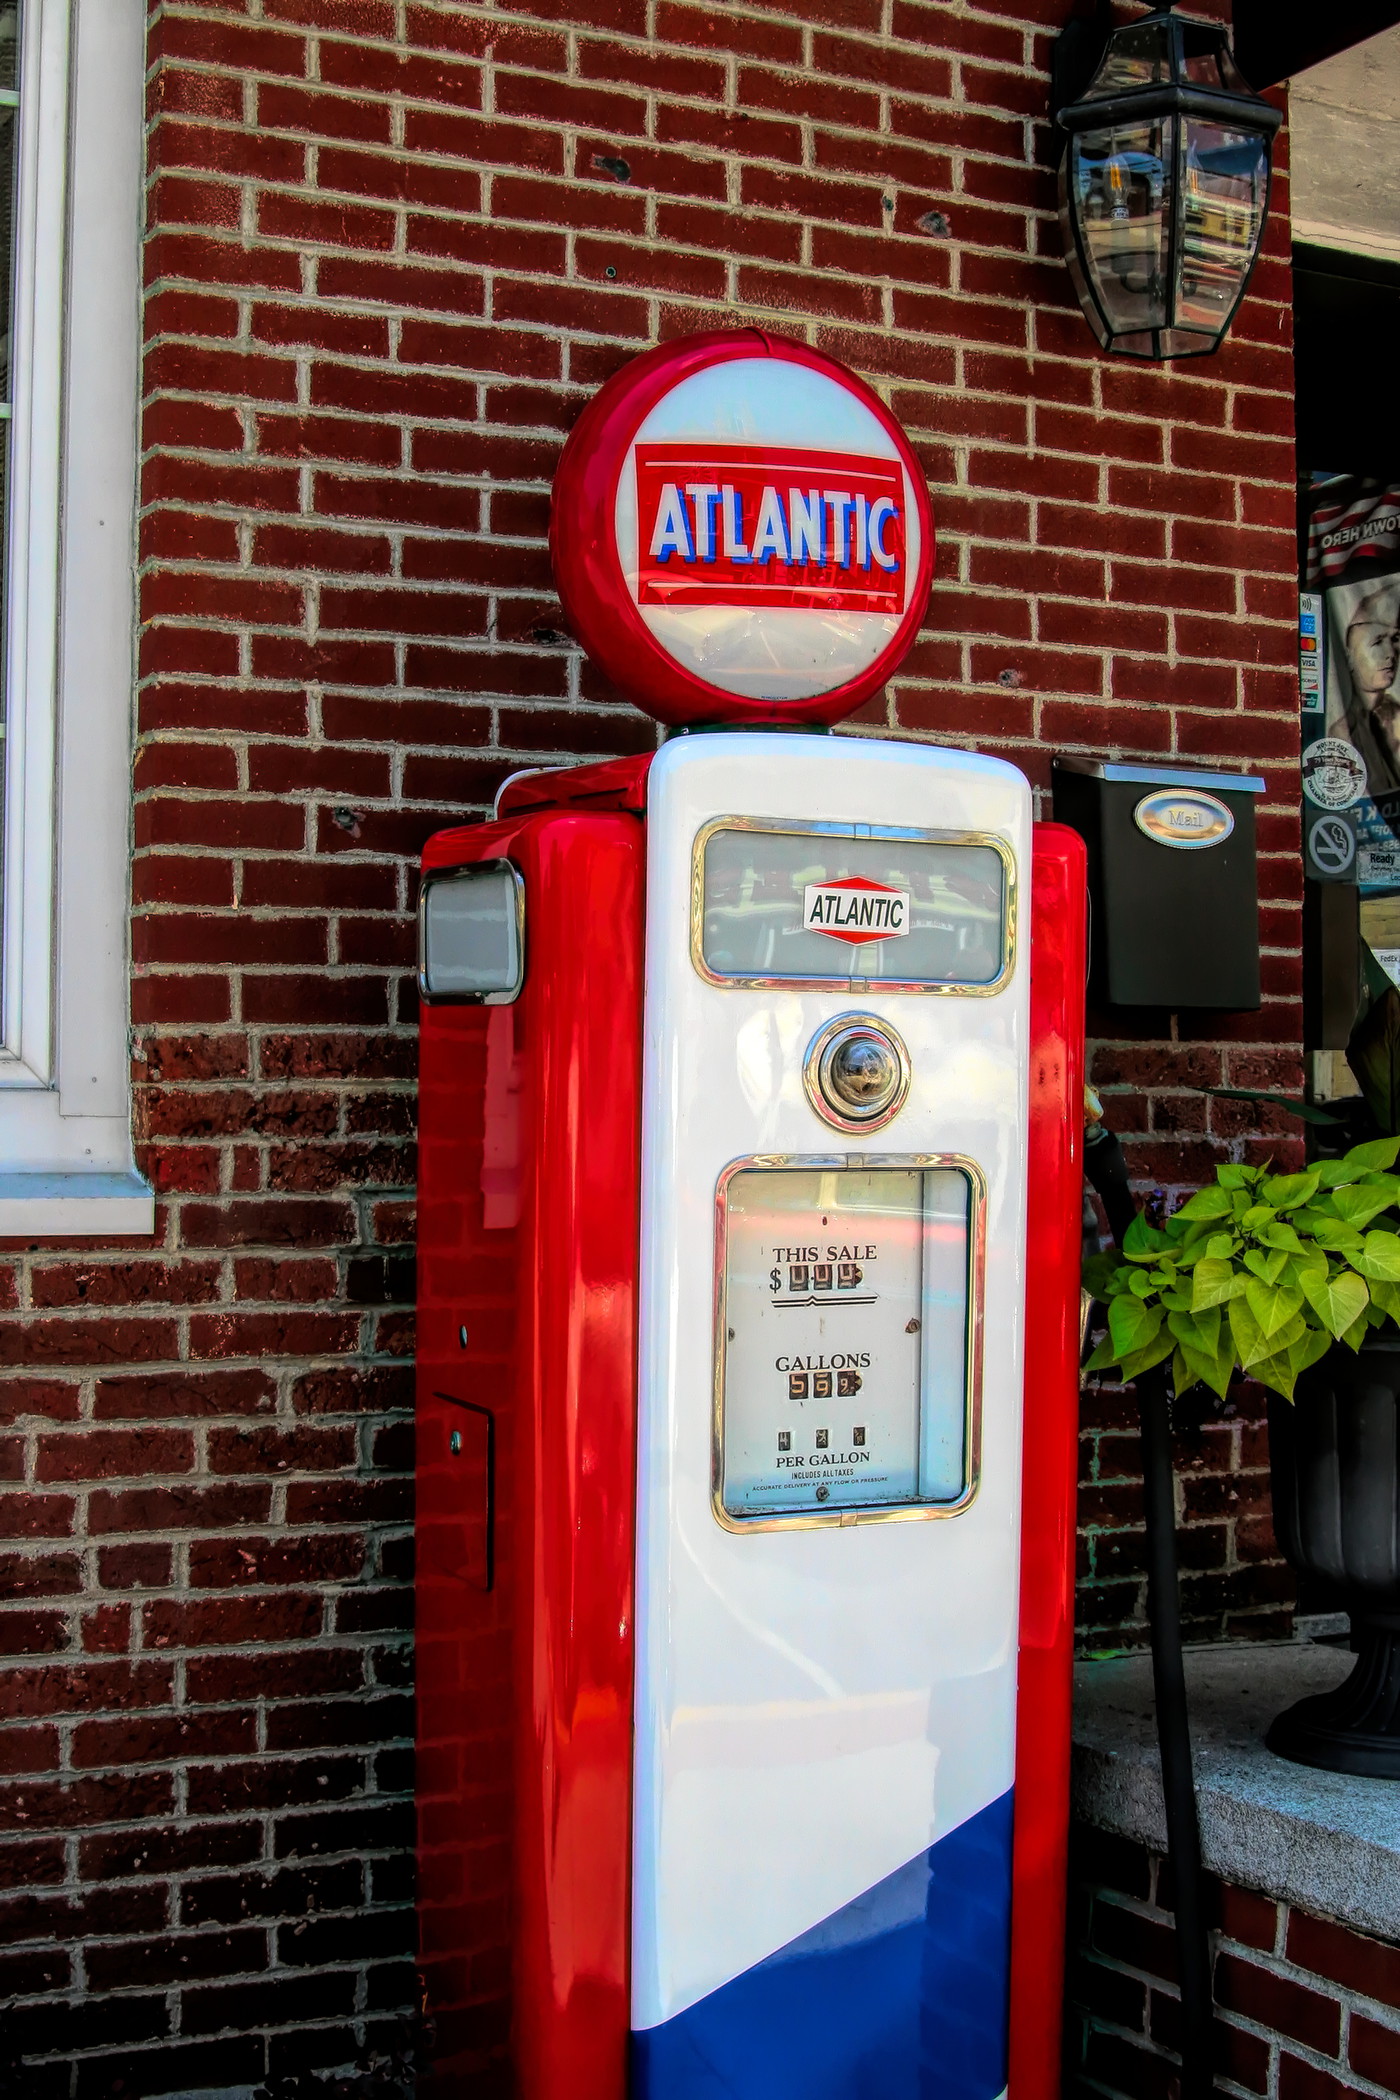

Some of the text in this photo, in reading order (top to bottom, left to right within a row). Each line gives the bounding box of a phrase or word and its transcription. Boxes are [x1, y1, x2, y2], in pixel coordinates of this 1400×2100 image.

[649, 483, 899, 572] ATLANTIC
[1301, 659, 1316, 667] VISA
[1308, 780, 1327, 805] CHAMBER
[1169, 810, 1204, 827] Mail
[1370, 853, 1395, 866] Ready
[810, 894, 904, 929] ATLANTIC
[772, 1245, 877, 1263] THIS SALE
[775, 1353, 871, 1372] GALLONS
[776, 1452, 870, 1468] PER GALLON
[791, 1468, 854, 1480] INCLUDES ALL TAXES
